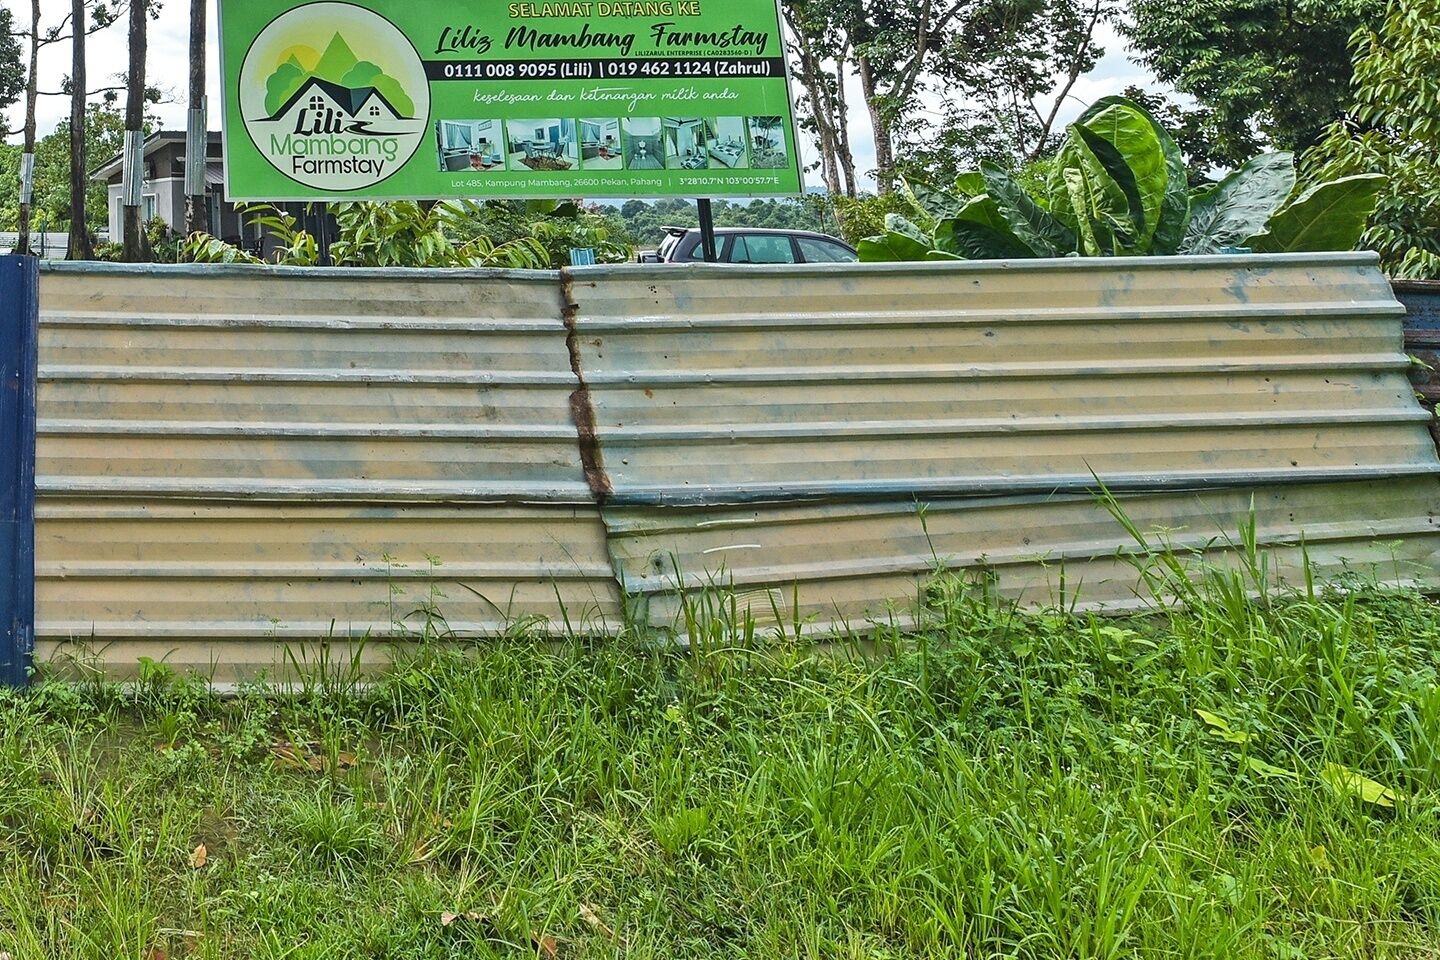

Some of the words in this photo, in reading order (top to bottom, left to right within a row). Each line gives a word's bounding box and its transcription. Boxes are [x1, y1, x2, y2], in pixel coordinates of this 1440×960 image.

[508, 1, 592, 19] SELAMAT
[598, 1, 672, 17] DATANG
[677, 0, 701, 16] KE
[434, 25, 494, 55] Liliz
[504, 23, 636, 57] Mambang
[649, 22, 769, 56] Farmstay
[666, 49, 702, 57] ENTERPRISE
[444, 64, 482, 78] 0111
[486, 63, 515, 78] 008
[518, 63, 557, 77] 9095
[560, 62, 593, 79] (Lili)
[608, 61, 638, 76] 019
[640, 61, 670, 76] 462
[674, 60, 712, 76] 1124
[714, 60, 771, 77] (Zahrul)
[546, 89, 575, 102] dan
[661, 87, 700, 100] milik
[702, 88, 740, 100] anda
[270, 134, 398, 162] Mambang
[293, 155, 385, 178] Farmstay
[451, 180, 465, 188] Lot
[466, 179, 484, 188] 485,
[485, 179, 526, 188] Kampung
[527, 178, 573, 187] Mambang,
[574, 178, 599, 186] 26600
[601, 178, 629, 186] Pekan,
[630, 178, 662, 187] Pahang
